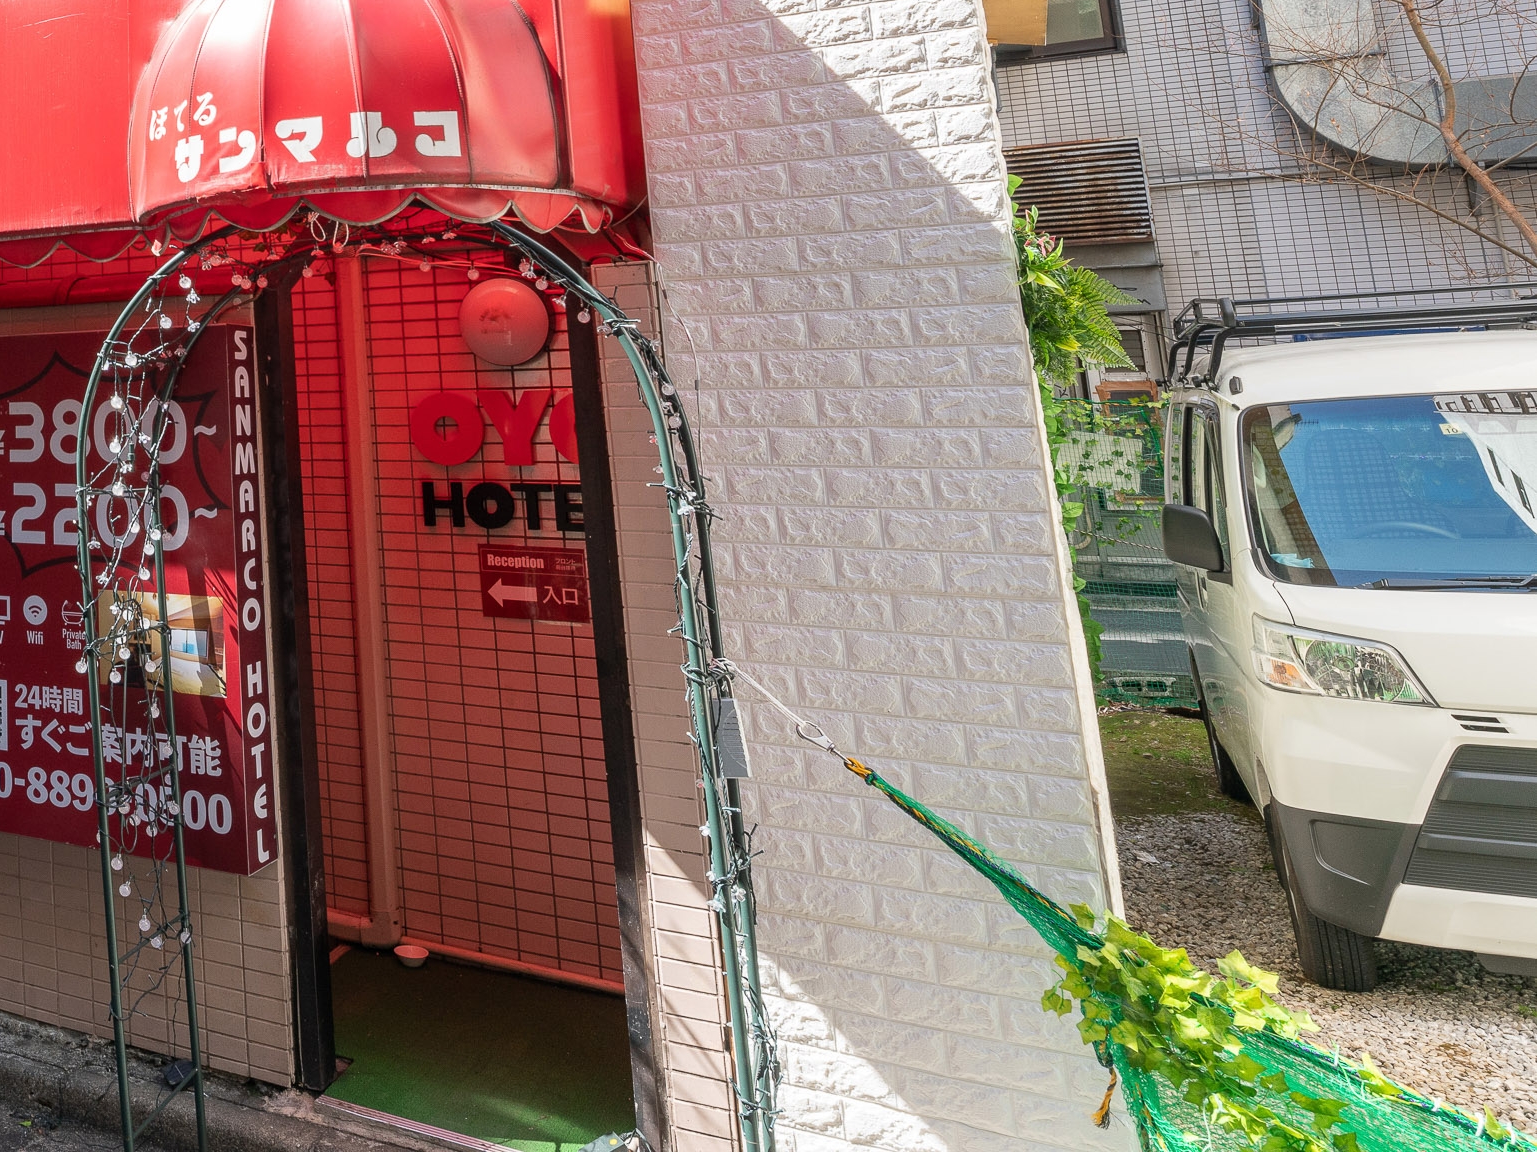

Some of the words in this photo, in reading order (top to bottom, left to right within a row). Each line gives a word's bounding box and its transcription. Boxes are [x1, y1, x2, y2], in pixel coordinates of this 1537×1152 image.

[148, 91, 217, 141] ほてる
[174, 110, 462, 183] サンマルコ
[233, 330, 261, 631] SANMARCO
[486, 553, 545, 569] Reception
[542, 585, 579, 606] 入口
[26, 630, 44, 646] Wifi
[62, 628, 86, 640] Private
[66, 638, 82, 650] Bath
[14, 683, 83, 715] 24時間
[15, 714, 223, 777] すぐご案内可能
[246, 660, 270, 864] HOTEL
